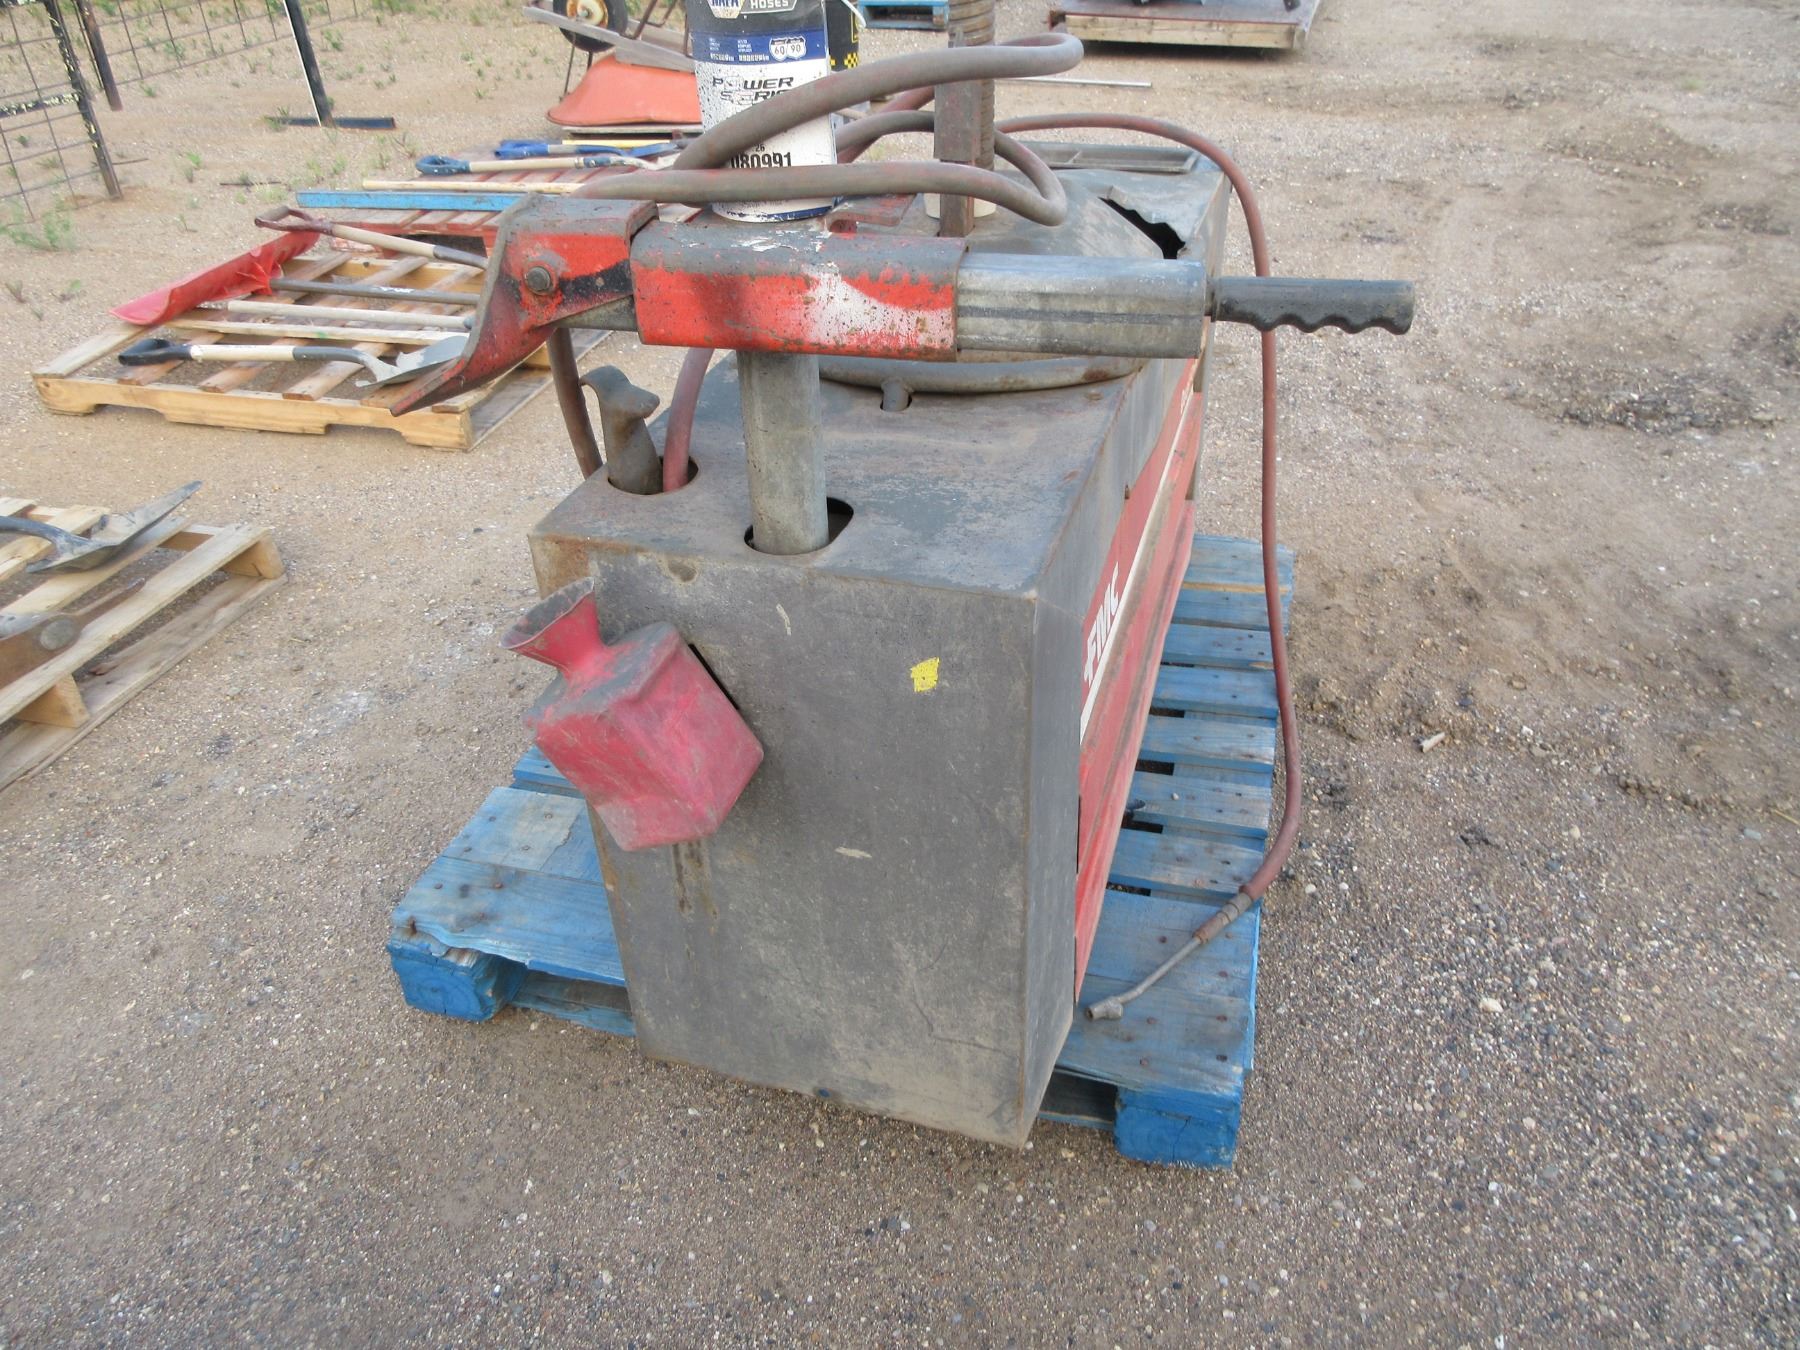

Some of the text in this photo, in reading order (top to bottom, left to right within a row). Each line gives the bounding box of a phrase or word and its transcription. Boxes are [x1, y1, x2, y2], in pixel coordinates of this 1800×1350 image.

[750, 0, 789, 9] HOSES
[790, 44, 801, 53] 90
[712, 75, 794, 91] POWER
